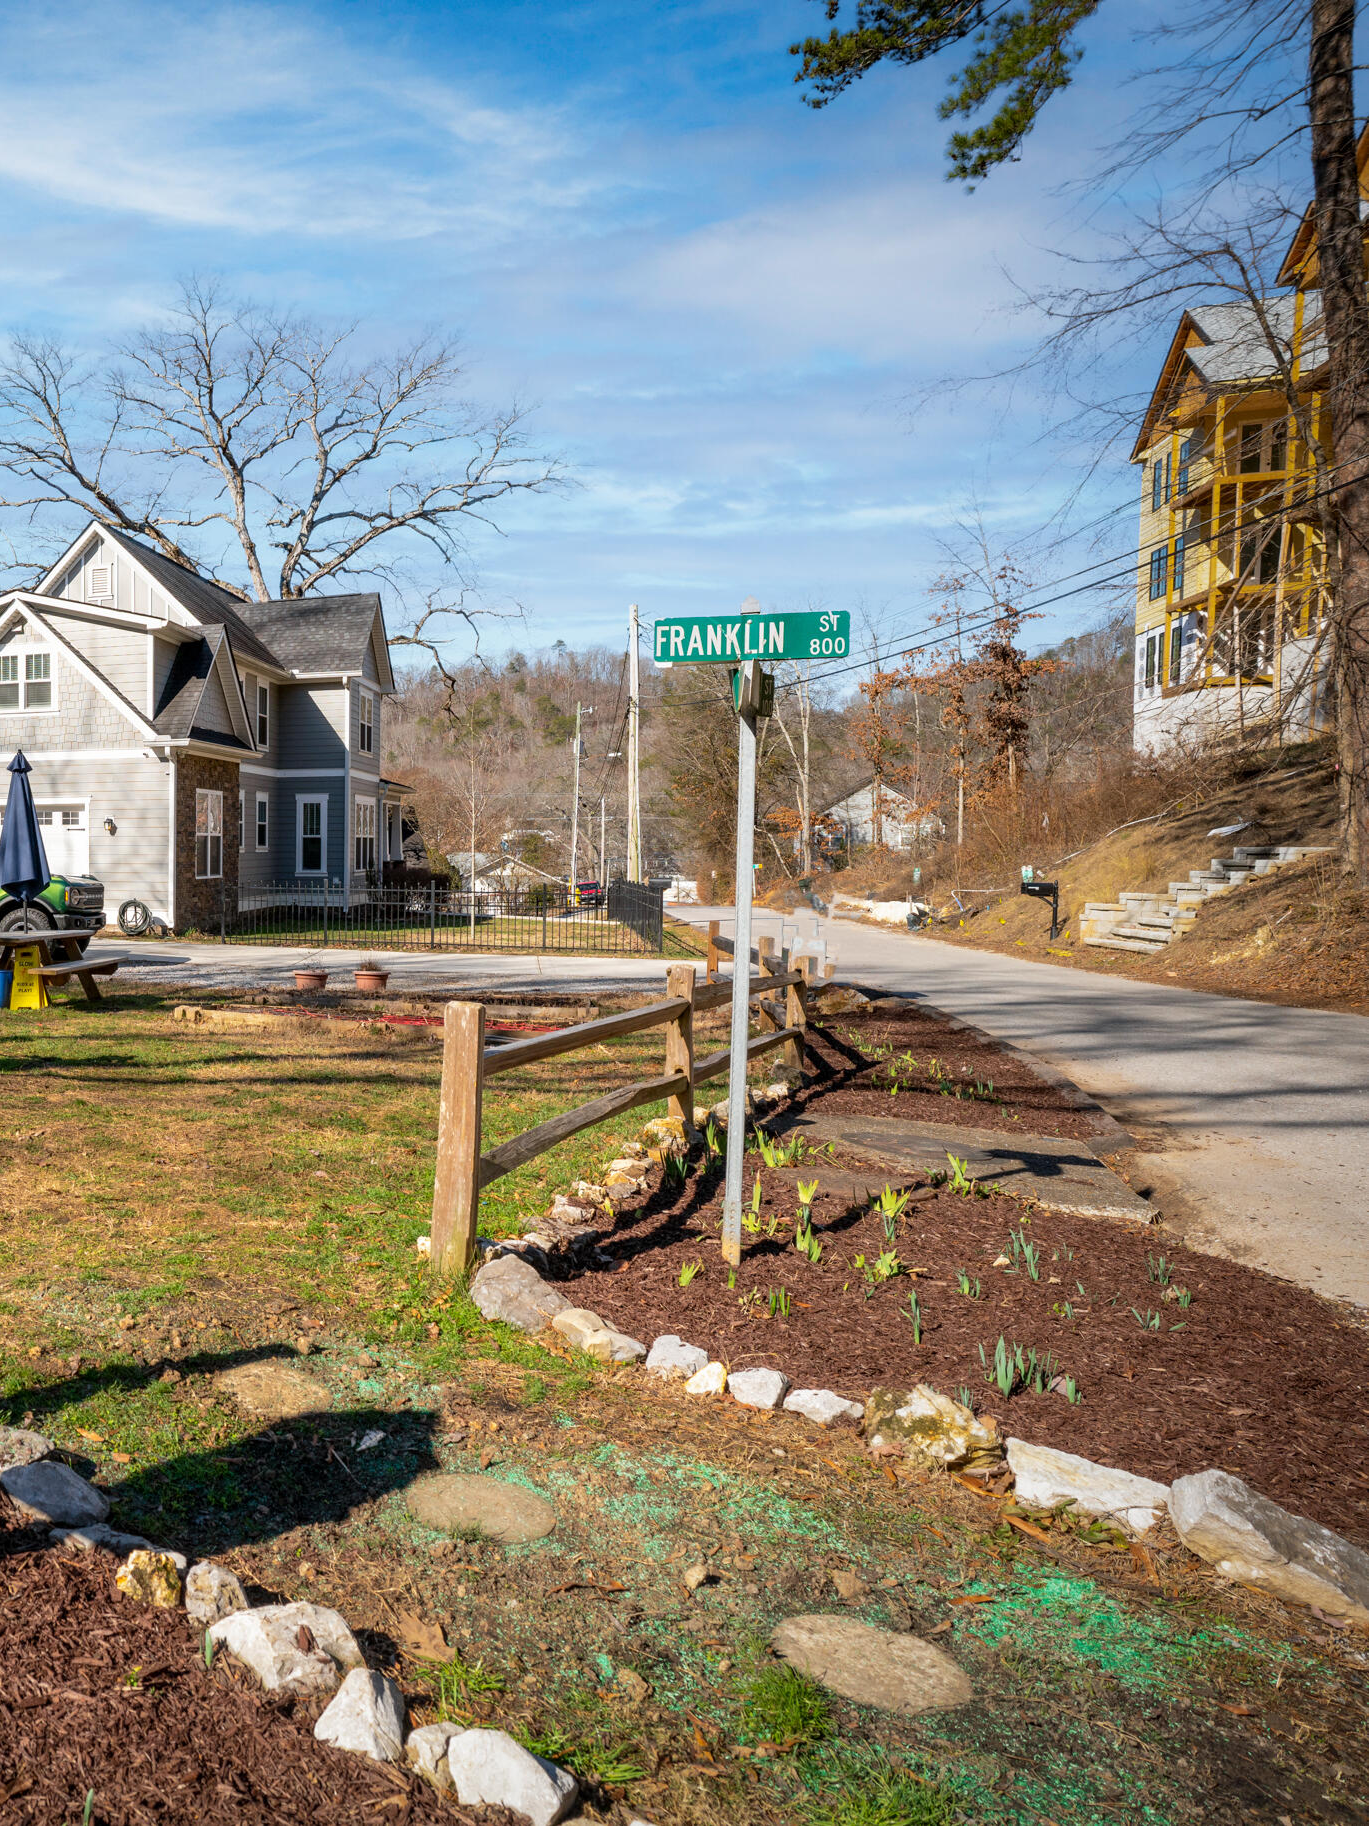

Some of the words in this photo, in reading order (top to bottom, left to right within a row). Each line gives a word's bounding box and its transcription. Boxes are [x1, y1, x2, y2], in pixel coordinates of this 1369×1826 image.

[655, 621, 785, 657] FRANKLIN
[819, 614, 840, 632] ST
[809, 637, 846, 656] 800
